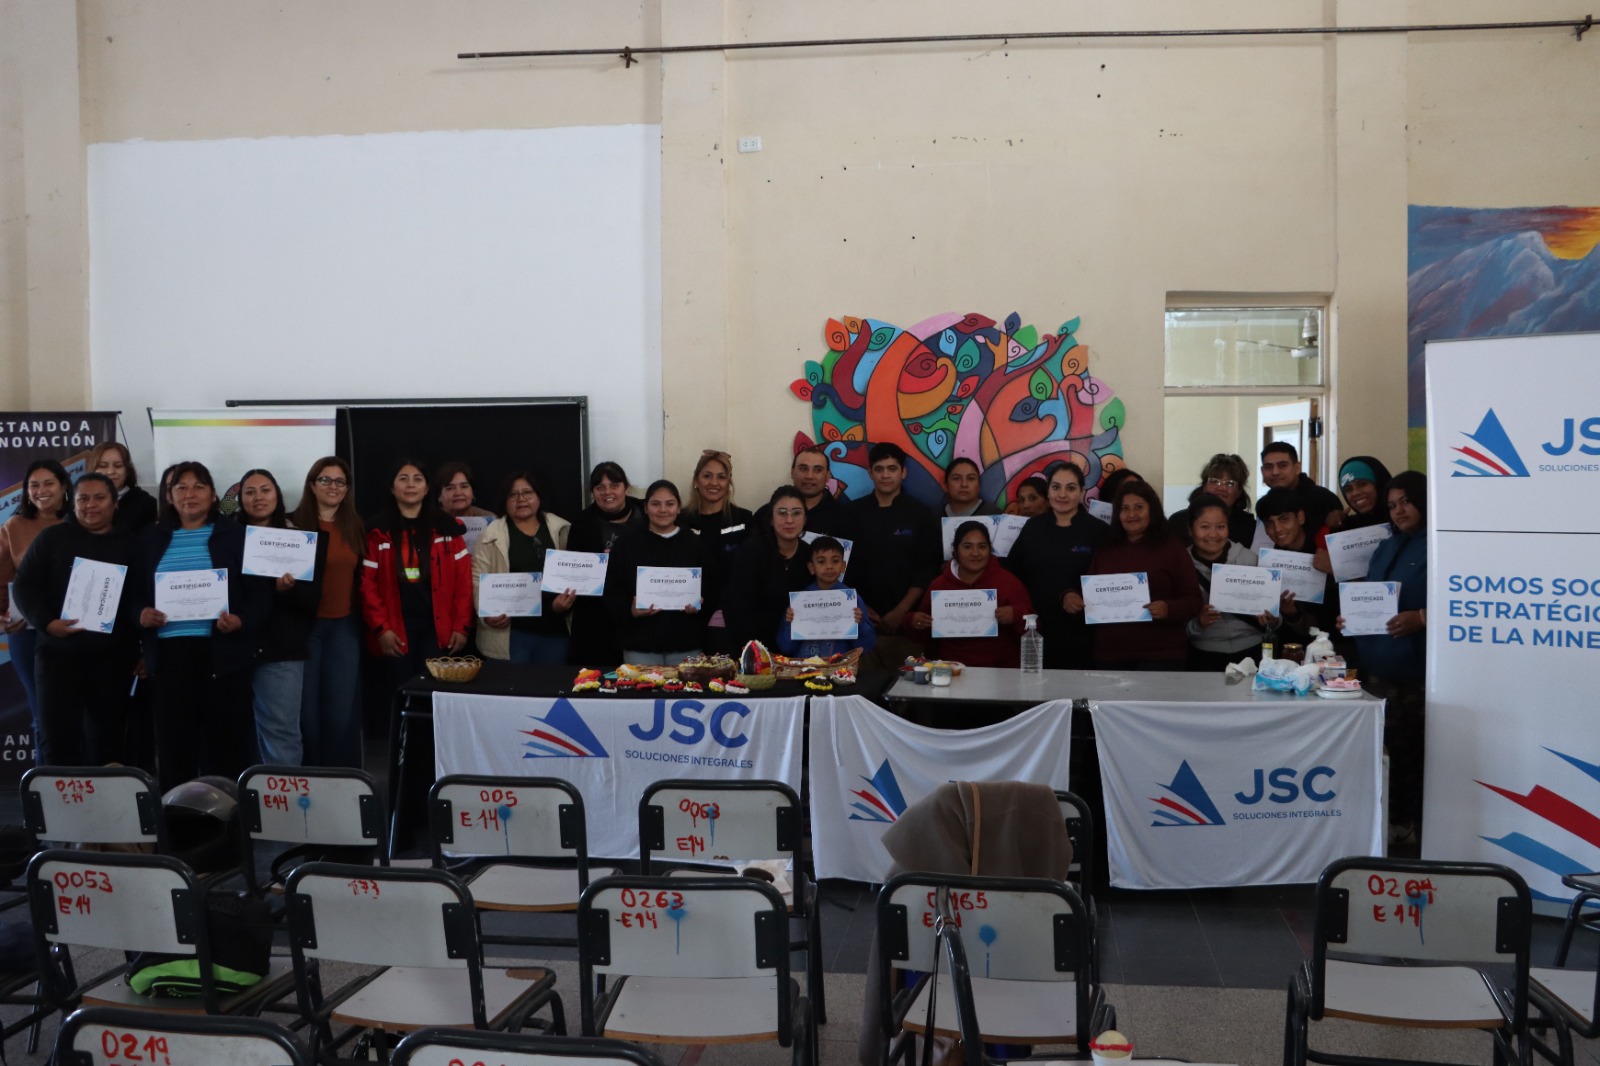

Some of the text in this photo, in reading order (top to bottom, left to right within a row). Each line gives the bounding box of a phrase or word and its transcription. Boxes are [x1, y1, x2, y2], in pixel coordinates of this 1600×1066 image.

[80, 420, 90, 431] A
[0, 433, 95, 448] NOVACIÓN
[1538, 464, 1600, 472] SOLUCIONES
[259, 540, 301, 549] CERTIFICADO
[1272, 562, 1311, 572] CERTIFICADO
[170, 582, 212, 590] CERTIFICADO
[1225, 577, 1265, 585] CERTIFICADO
[1448, 574, 1544, 595] SOMOS
[1095, 585, 1134, 593] CERTIFICADO
[804, 601, 842, 609] CERTIFICADO
[1449, 624, 1600, 649] DE LA MINE
[628, 698, 751, 749] JSC
[625, 749, 753, 769] SOLUCIONES INTEGRALES
[1234, 765, 1336, 805] JSC
[480, 789, 518, 807] 005
[1232, 809, 1342, 820] SOLUCIONES INTEGRALES
[54, 870, 113, 893] 0053
[621, 887, 684, 911] 0263
